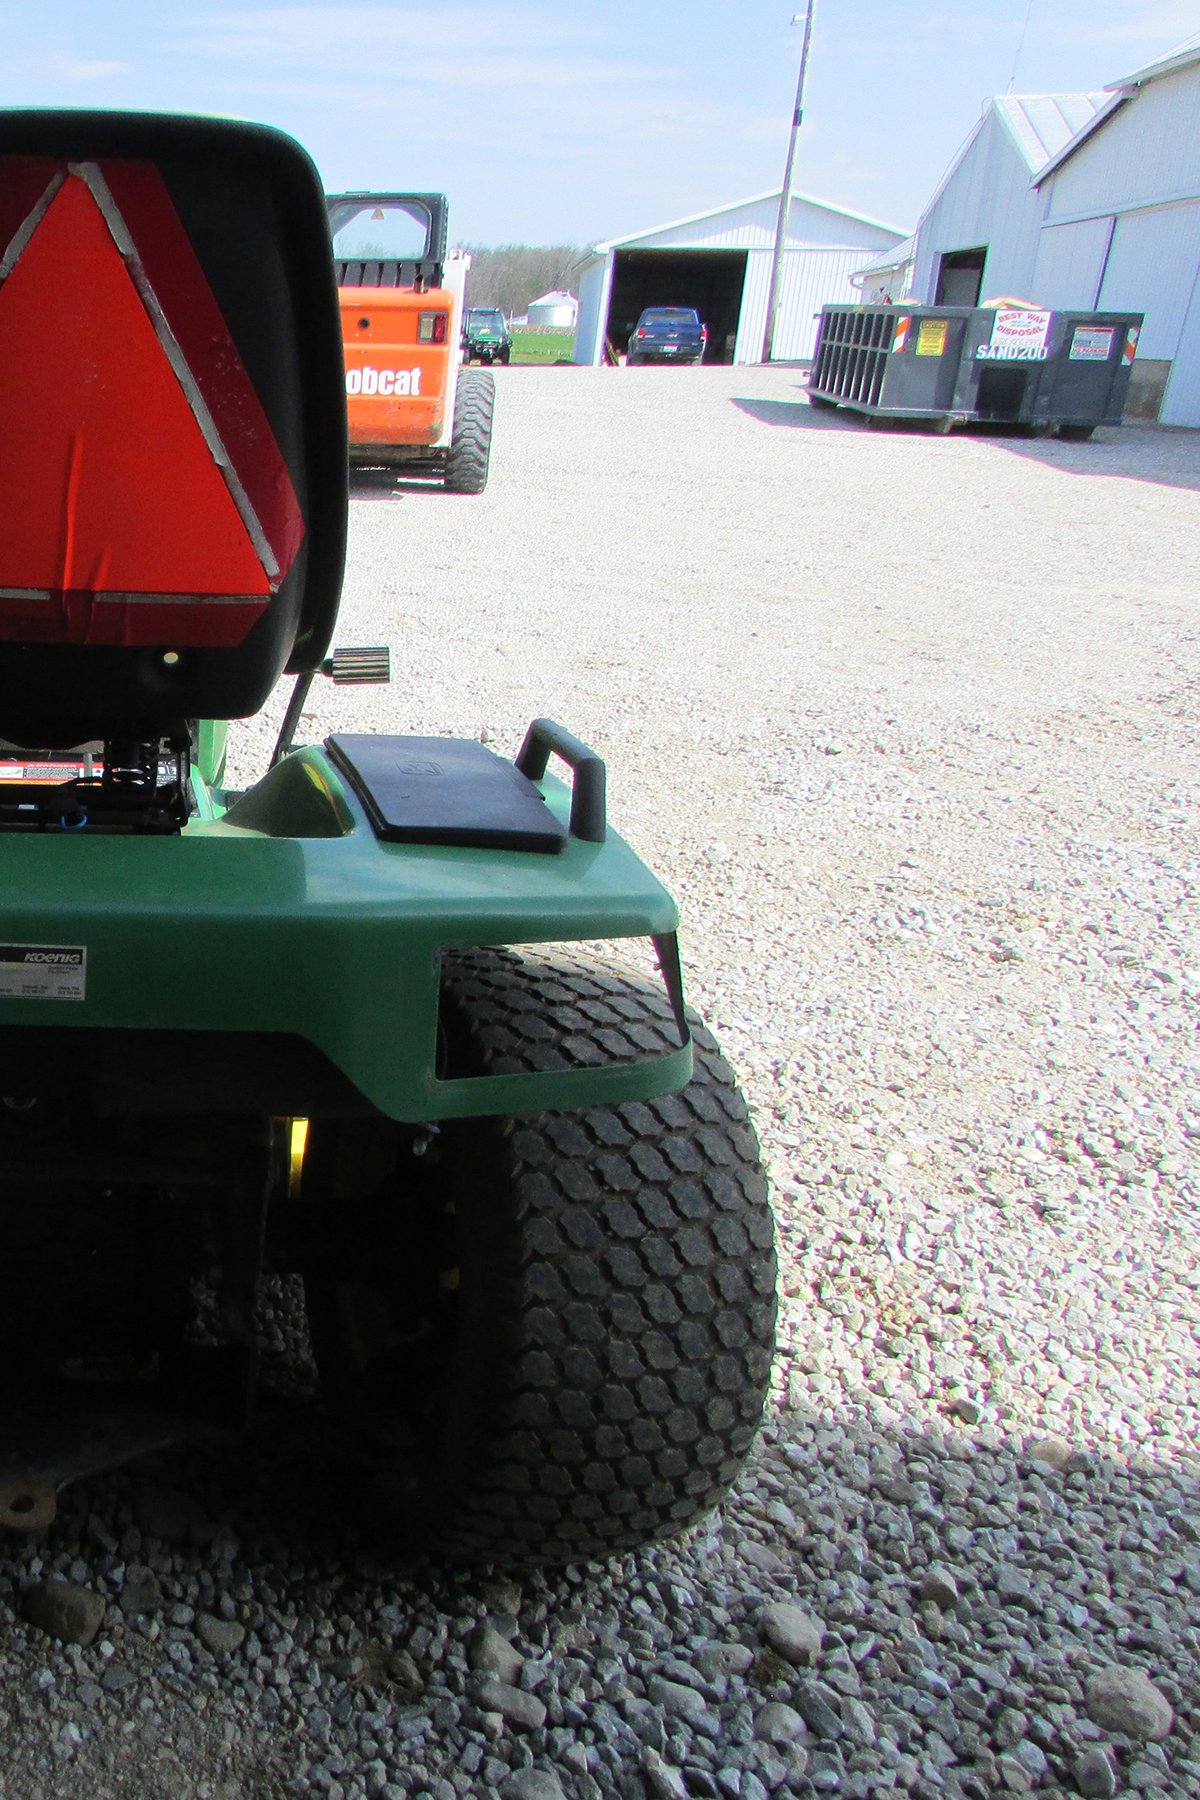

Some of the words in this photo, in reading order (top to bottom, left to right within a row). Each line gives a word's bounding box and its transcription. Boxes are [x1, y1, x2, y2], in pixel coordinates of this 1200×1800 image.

[998, 313, 1023, 322] BEST
[1026, 313, 1047, 324] WAY
[995, 324, 1045, 336] DISPOSAL
[976, 344, 1048, 360] SAND200
[345, 366, 422, 396] obcat
